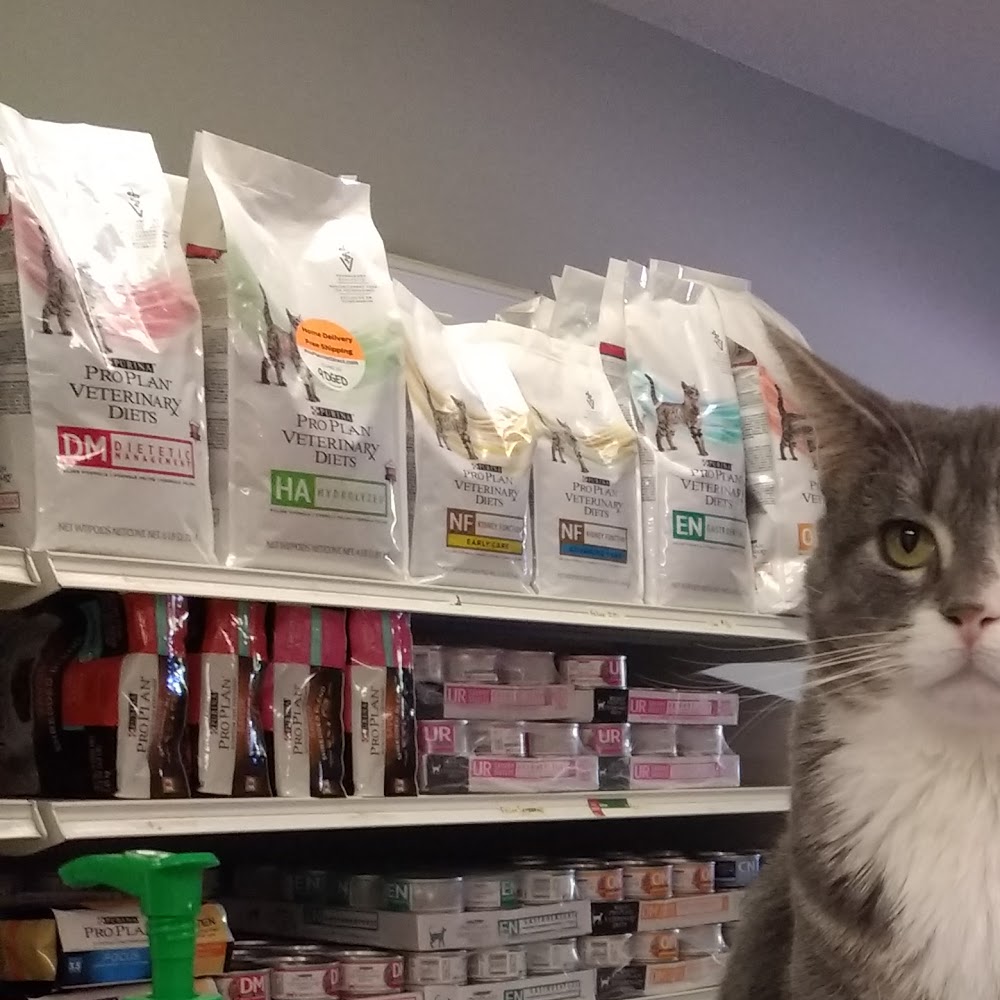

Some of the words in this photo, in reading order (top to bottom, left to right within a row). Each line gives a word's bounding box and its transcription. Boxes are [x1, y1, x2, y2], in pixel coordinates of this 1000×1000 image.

[305, 338, 320, 347] Free
[321, 344, 354, 356] Shipping
[323, 332, 353, 344] Delivery
[113, 359, 153, 373] PURINA
[85, 365, 123, 383] PRO
[127, 371, 171, 391] PLAN
[69, 382, 182, 416] VETERINARY
[109, 405, 158, 424] DIETS
[296, 414, 327, 431] PRO
[330, 419, 373, 437] PLAN
[62, 432, 107, 462] DM
[114, 441, 191, 460] DIETETIC
[281, 429, 380, 461] VETERINARY
[114, 453, 192, 468] MANAGEMENT
[315, 450, 357, 468] DIETS
[276, 475, 311, 503] HA
[454, 480, 519, 501] VETERINARY
[476, 494, 504, 507] DIETS
[565, 493, 623, 513] VETERINARY
[705, 495, 733, 509] DIETS
[584, 506, 609, 518] DIETS
[449, 512, 474, 532] NF
[676, 515, 703, 537] EN
[561, 523, 583, 540] NF
[608, 662, 621, 678] U
[220, 678, 231, 718] PLAN
[448, 687, 467, 704] UR
[370, 688, 380, 728] PLAN
[630, 699, 648, 714] UR
[219, 721, 230, 750] PRO
[293, 728, 303, 755] PRO
[370, 729, 380, 755] PRO
[424, 725, 451, 742] UR
[599, 729, 621, 744] UR
[472, 761, 492, 777] UR
[634, 765, 651, 778] UR
[389, 883, 409, 899] EN
[84, 926, 114, 939] PRO
[116, 926, 148, 938] PLA
[500, 922, 519, 936] EN
[239, 977, 266, 994] DM
